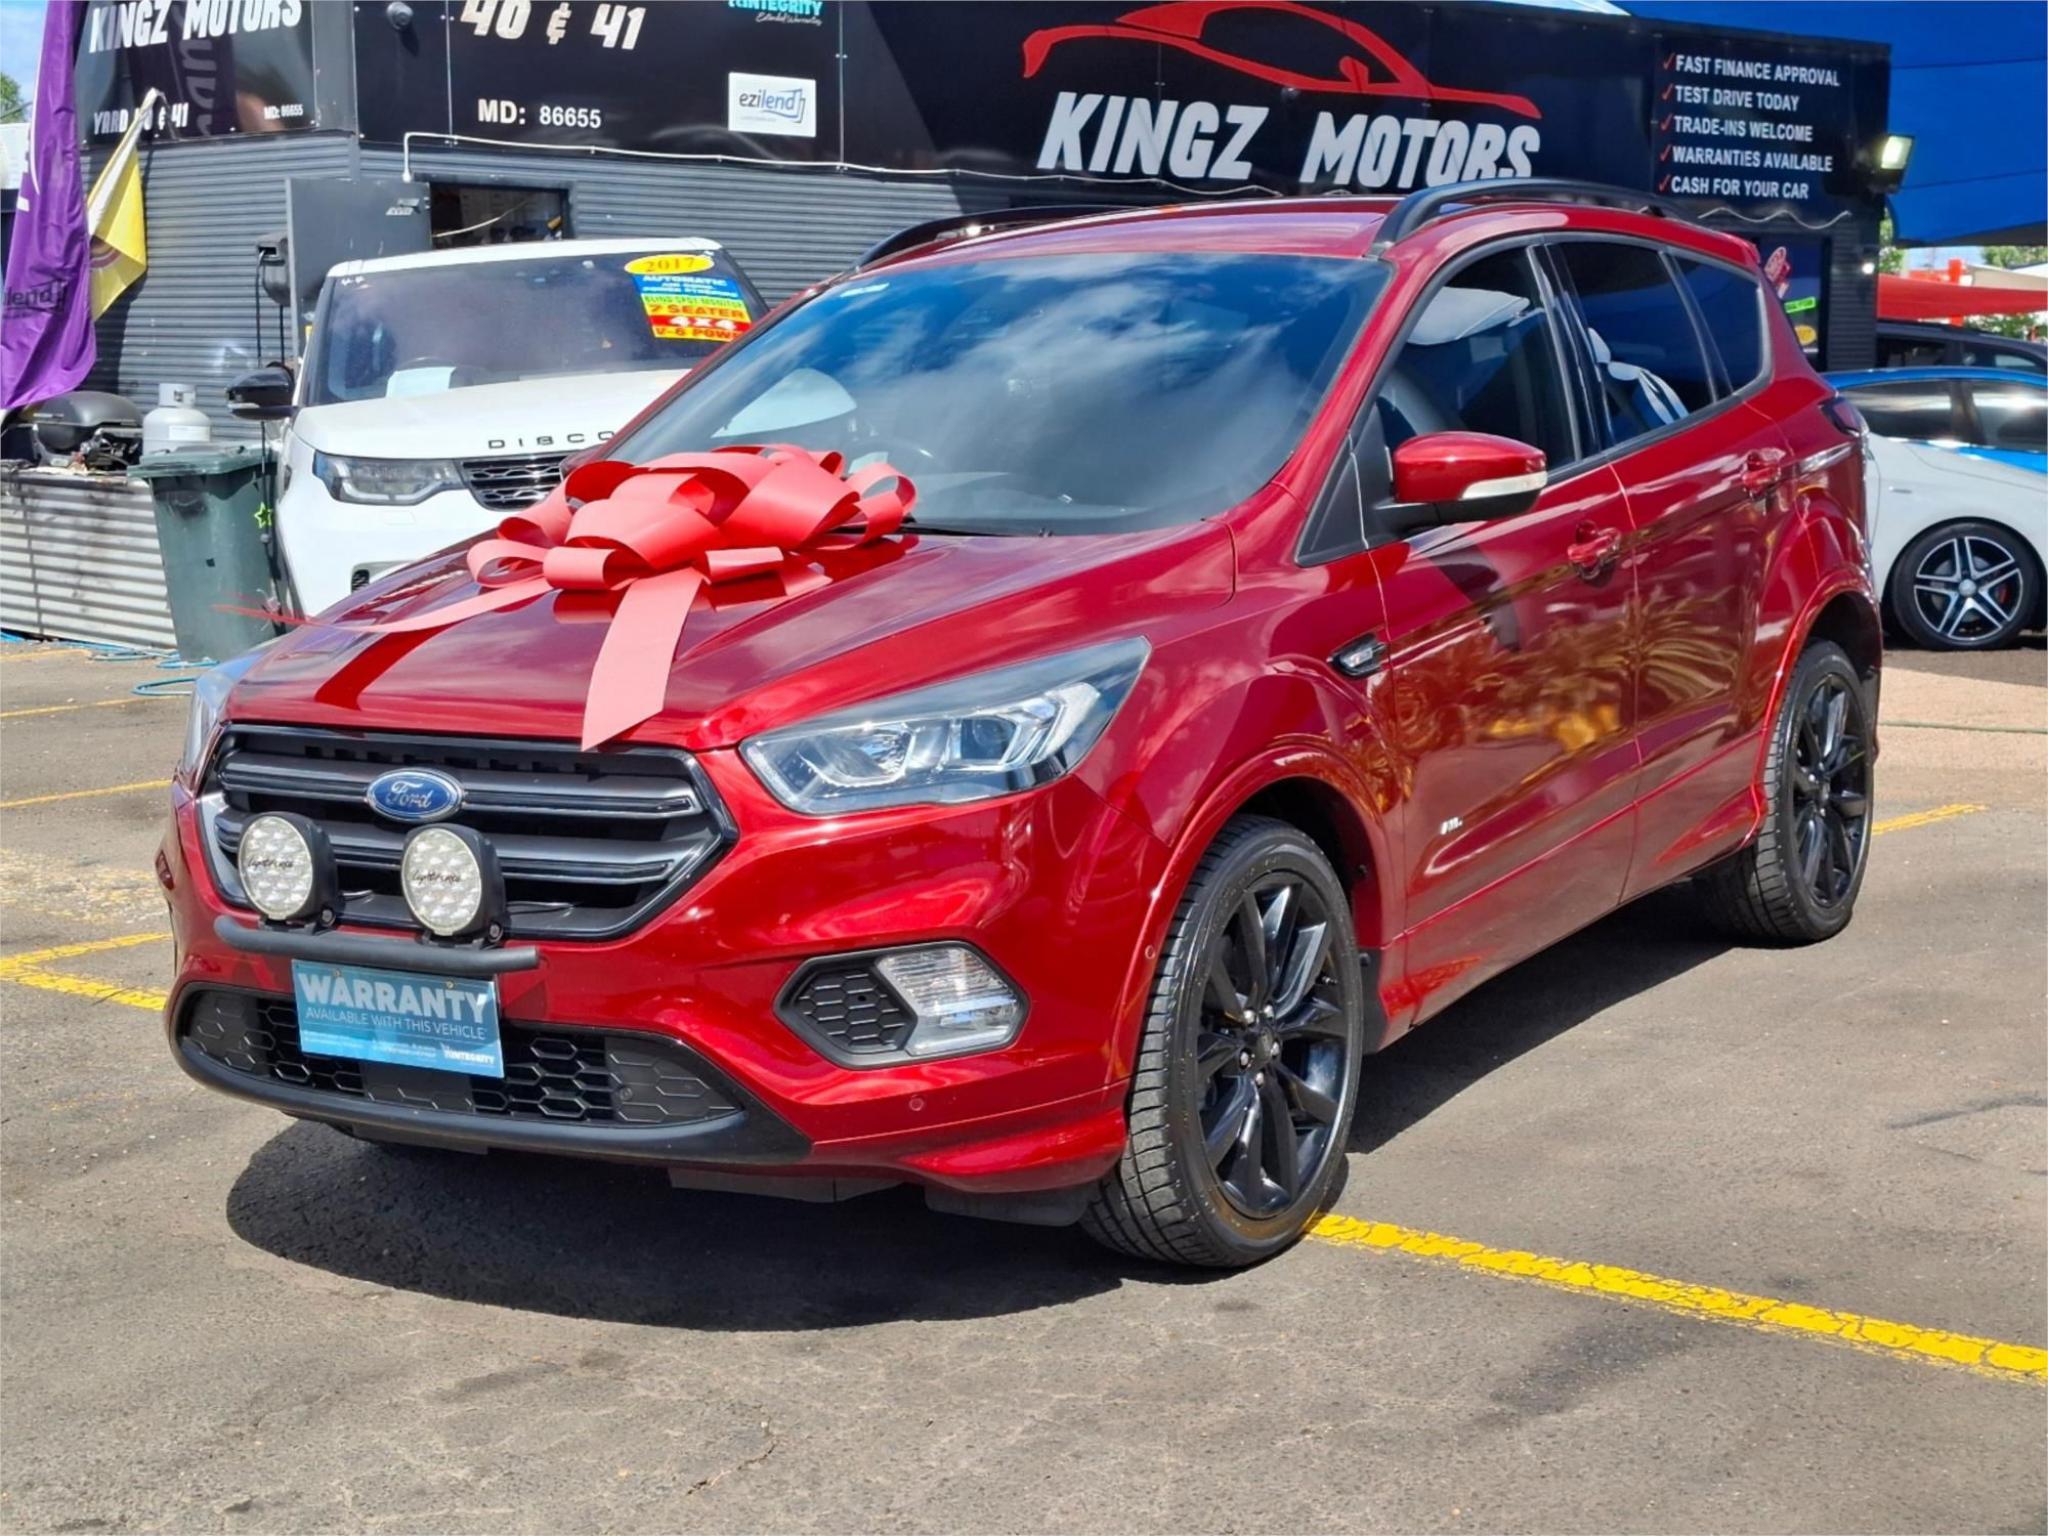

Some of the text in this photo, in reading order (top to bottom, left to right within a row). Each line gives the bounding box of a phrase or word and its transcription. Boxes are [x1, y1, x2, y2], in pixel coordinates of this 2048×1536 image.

[89, 0, 171, 53] KINGZ
[460, 0, 531, 39] 40
[590, 3, 647, 50] 41
[1675, 54, 1841, 87] FAST FINANCE APPROVAL
[738, 89, 797, 111] ezilend
[1675, 85, 1800, 112] TEST DRIVE TODAY
[93, 109, 129, 135] YARD
[171, 102, 189, 128] 41
[477, 98, 602, 129] MD: 86655
[1036, 91, 1541, 189] KINGZ MOTORS
[1674, 115, 1813, 142] TRADE-INS WELCOME
[1673, 145, 1833, 172] WARRANTIES AVAILABLE
[1671, 175, 1809, 199] CASH FOR YOUR CAR
[643, 256, 696, 273] 2017
[649, 303, 744, 318] 7 SEATER
[488, 430, 615, 449] DISCO
[385, 780, 434, 808] Ford
[298, 973, 488, 1023] WARRANTY
[305, 1007, 487, 1041] AVAILABLE WITH THIS VEHICLE
